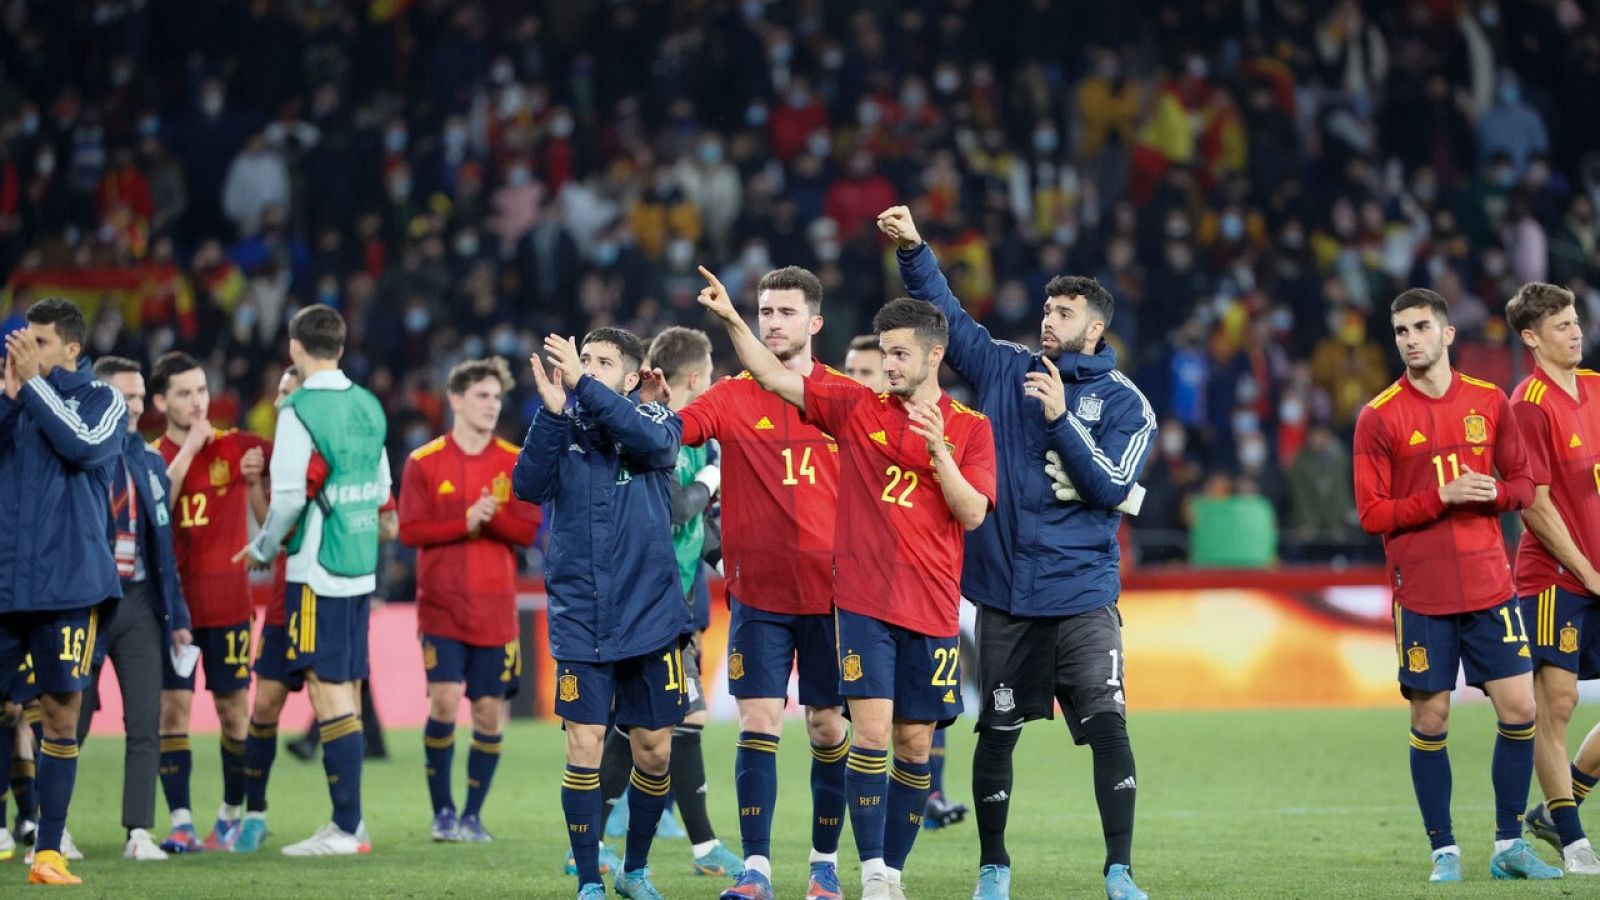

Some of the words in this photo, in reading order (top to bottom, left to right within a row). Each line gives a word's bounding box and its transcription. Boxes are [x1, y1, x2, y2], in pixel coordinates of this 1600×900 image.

[782, 447, 816, 485] 14
[1432, 453, 1460, 487] 11
[881, 465, 919, 508] 22
[180, 493, 209, 528] 12
[1499, 606, 1529, 643] 11
[59, 626, 85, 662] 16
[224, 630, 250, 664] 12
[931, 647, 959, 686] 22
[1106, 649, 1123, 686] 1
